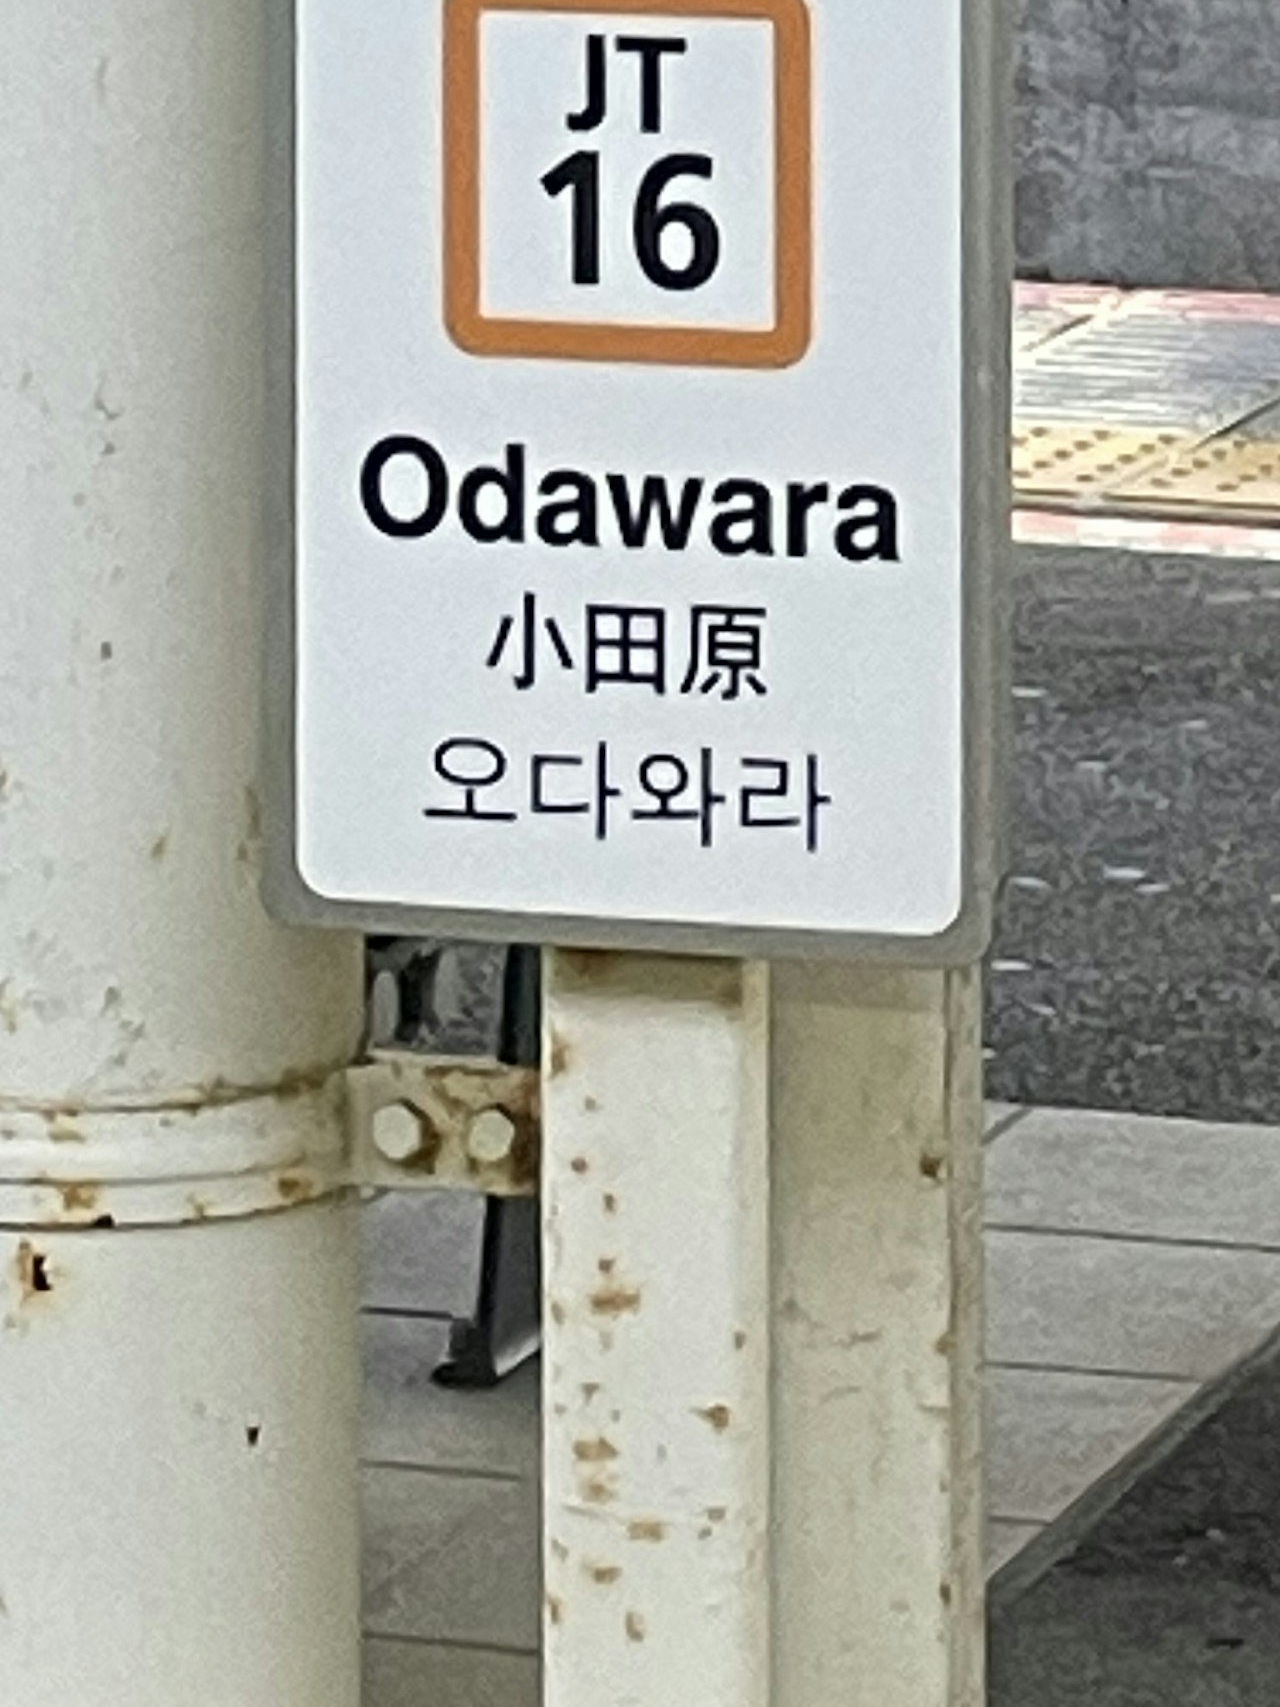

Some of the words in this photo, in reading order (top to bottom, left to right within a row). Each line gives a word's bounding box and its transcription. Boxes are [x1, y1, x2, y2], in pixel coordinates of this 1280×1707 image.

[566, 34, 687, 134] JT
[540, 150, 720, 291] 16
[360, 435, 899, 562] Odawara
[486, 592, 768, 701] 小田原
[424, 737, 832, 853] 오다와라
